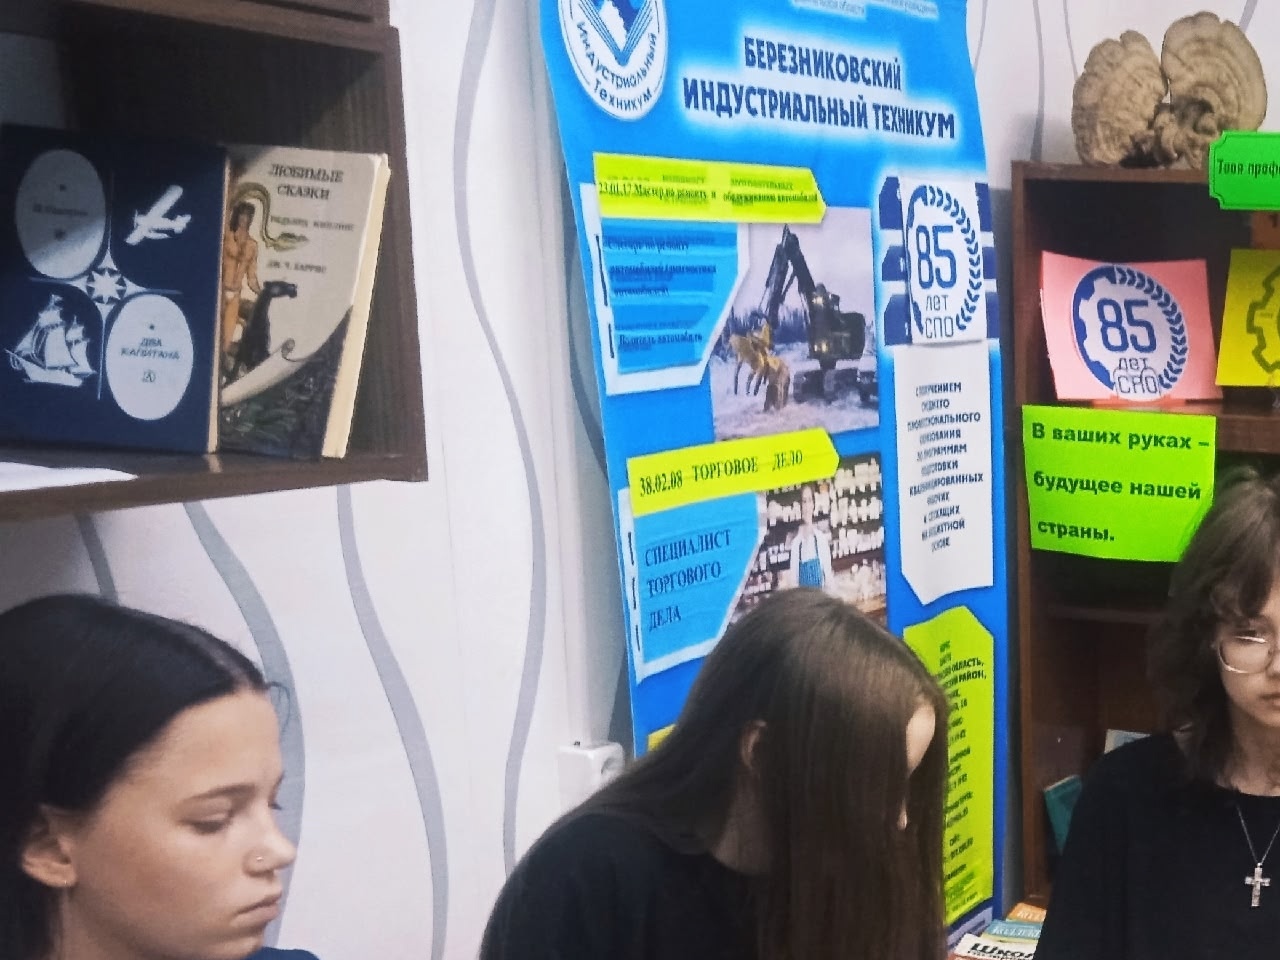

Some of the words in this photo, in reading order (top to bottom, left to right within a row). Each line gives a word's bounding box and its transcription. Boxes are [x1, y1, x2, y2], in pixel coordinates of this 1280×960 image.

[744, 36, 901, 91] БЕРЕЗНИКОВСКИЙ
[683, 77, 869, 129] ИНДУСТРИАЛЬНЫЙ
[872, 103, 955, 139] ТЕХНИКУМ
[269, 163, 344, 183] ЛЮБИМЫЕ
[1217, 160, 1244, 175] Твоя
[277, 184, 330, 200] СКАЗКИ
[916, 225, 957, 290] 85
[925, 316, 954, 339] СПО
[1096, 298, 1157, 353] 85
[1032, 422, 1045, 439] В
[1053, 427, 1121, 444] ваших
[1128, 432, 1191, 450] руках
[640, 470, 684, 497] 38.02.08
[692, 456, 759, 480] ТОРГОВОЕ
[771, 450, 803, 471] ДЕЛО
[1033, 470, 1123, 495] будущее
[1130, 482, 1201, 499] нашей
[1037, 520, 1115, 541] страны.
[645, 530, 731, 567] СПЕЦИАЛИСТ
[647, 561, 722, 597] ТОРГОВОГО
[649, 605, 682, 632] ДЕЛА
